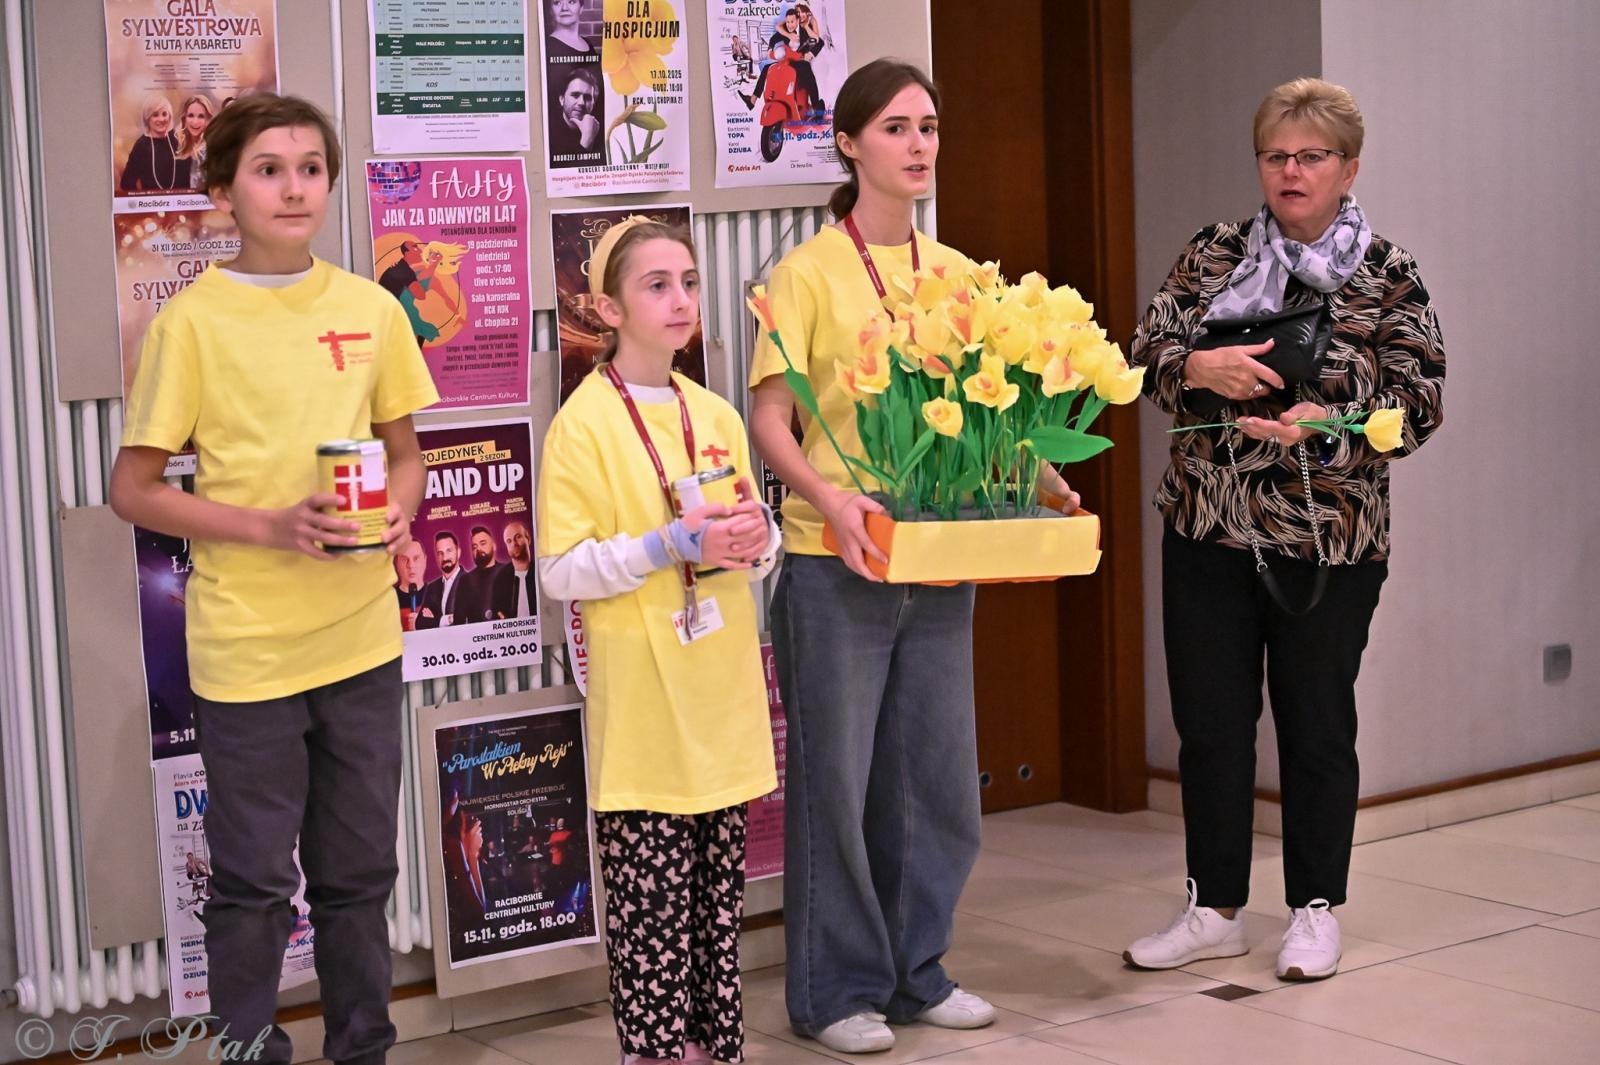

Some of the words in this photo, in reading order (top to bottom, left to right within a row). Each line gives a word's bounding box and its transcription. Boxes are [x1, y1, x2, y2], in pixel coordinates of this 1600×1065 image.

[167, 0, 217, 17] GALA
[627, 1, 650, 18] DLA
[725, 7, 735, 15] na
[738, 4, 781, 19] zakręcie
[122, 18, 262, 37] SYLWESTROWA
[604, 21, 680, 39] HOSPICJUM
[145, 39, 151, 50] Z
[153, 38, 182, 52] NUTĄ
[185, 38, 241, 50] KABARETU
[650, 70, 682, 79] 17.10.2025
[382, 208, 406, 227] JAK
[409, 208, 424, 226] ZA
[428, 206, 490, 226] DAWNYCH
[494, 205, 516, 223] LAT
[160, 243, 170, 252] XII
[171, 242, 192, 251] 2025
[467, 240, 474, 249] 19
[485, 452, 506, 461] SEZON
[425, 467, 482, 499] AND
[488, 463, 525, 493] UP
[492, 618, 536, 631] RACIBORSKIE
[472, 632, 505, 643] CENTRUM
[506, 628, 537, 639] KULTURY
[422, 654, 459, 668] 30.10.
[464, 647, 498, 664] godz.
[500, 642, 538, 657] 20.00
[481, 760, 499, 780] W
[501, 789, 530, 800] POLSKIE
[531, 784, 566, 794] PRZEBOJE
[177, 823, 188, 832] na
[494, 892, 544, 908] RACIBORSKIE
[484, 907, 521, 921] CENTRUM
[521, 900, 555, 914] KULTURY
[464, 926, 496, 943] 15.11.
[499, 919, 537, 939] godz.
[539, 912, 576, 929] 18.00
